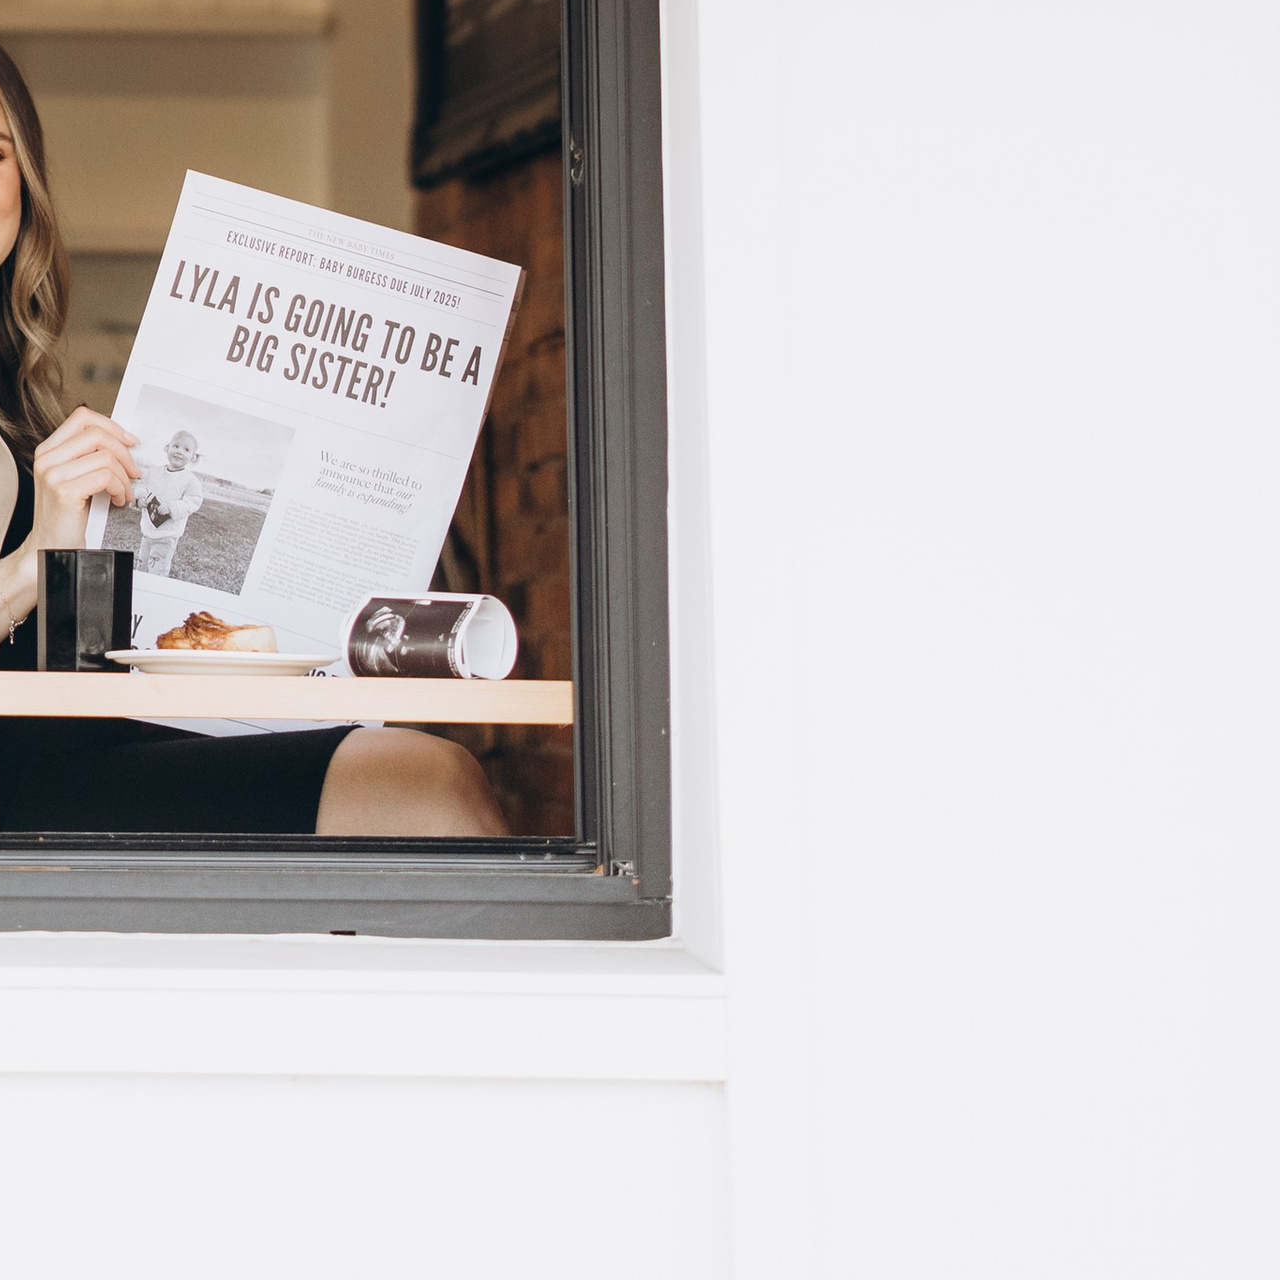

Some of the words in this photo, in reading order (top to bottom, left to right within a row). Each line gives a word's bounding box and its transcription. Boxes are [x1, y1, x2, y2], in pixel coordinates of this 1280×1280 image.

[226, 230, 277, 255] EXCLUSIVE
[278, 245, 317, 267] REPORT:
[319, 257, 345, 274] BABY
[346, 265, 388, 288] BURGESS
[390, 277, 408, 294] DUE
[410, 283, 432, 301] JULY
[433, 290, 462, 310] 2025!
[170, 260, 240, 315] LYLA
[246, 282, 280, 324] IS
[284, 294, 373, 353] GOING
[380, 319, 416, 365] TO
[420, 332, 460, 378] BE
[461, 345, 482, 386] A
[226, 325, 279, 373] BIG
[283, 343, 396, 409] SISTER!
[311, 476, 347, 498] family
[347, 486, 356, 498] is
[356, 491, 413, 514] expanding!
[319, 467, 372, 489] announce
[373, 481, 394, 496] that
[395, 490, 415, 500] our
[320, 450, 339, 466] We
[339, 460, 357, 472] are
[358, 466, 370, 476] so
[371, 467, 410, 487] thrilled
[411, 479, 423, 491] to
